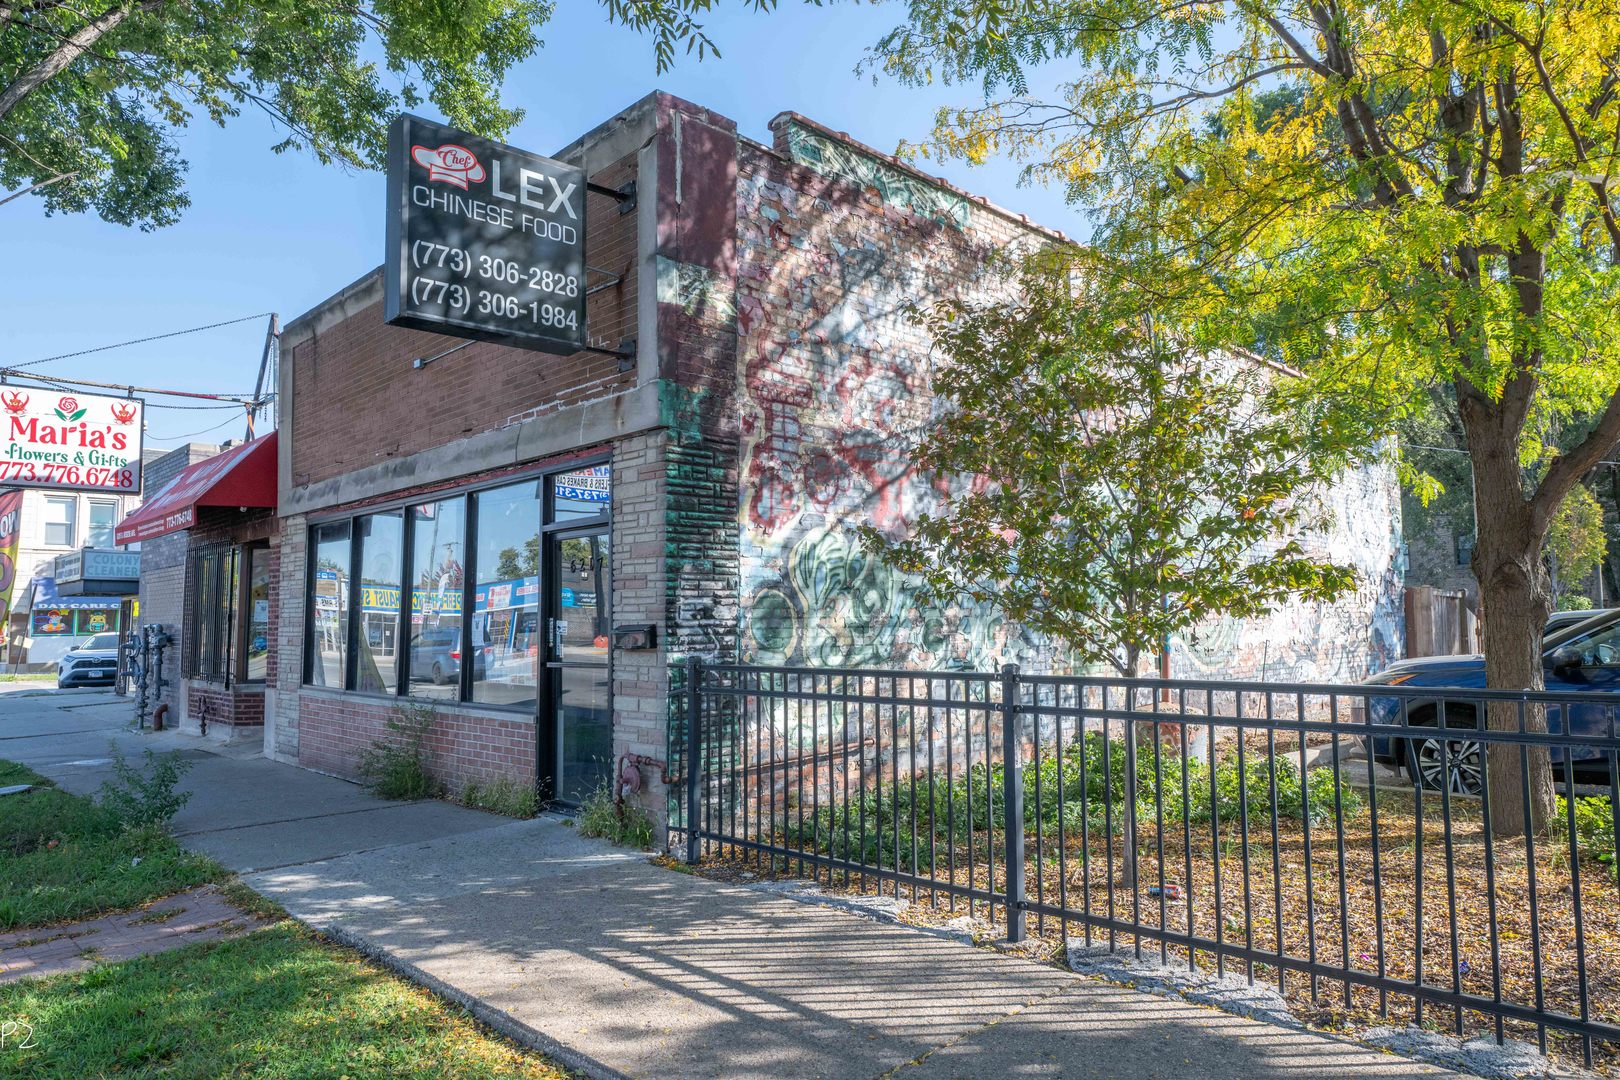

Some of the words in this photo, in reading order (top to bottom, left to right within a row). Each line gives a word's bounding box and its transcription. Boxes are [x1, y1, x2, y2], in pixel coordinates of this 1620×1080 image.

[438, 150, 472, 170] Chef
[492, 159, 577, 220] LEX
[413, 185, 514, 230] CHINESE
[521, 214, 577, 246] FOOD
[412, 239, 472, 279] (773)
[478, 255, 578, 298] 306-2828
[411, 276, 472, 314] (773)
[478, 290, 578, 332] 306-1984
[8, 415, 128, 451] Maria's
[0, 460, 133, 489] 773.776.6748
[73, 451, 85, 467] &
[88, 449, 128, 469] Gifts
[93, 554, 140, 566] COLONY
